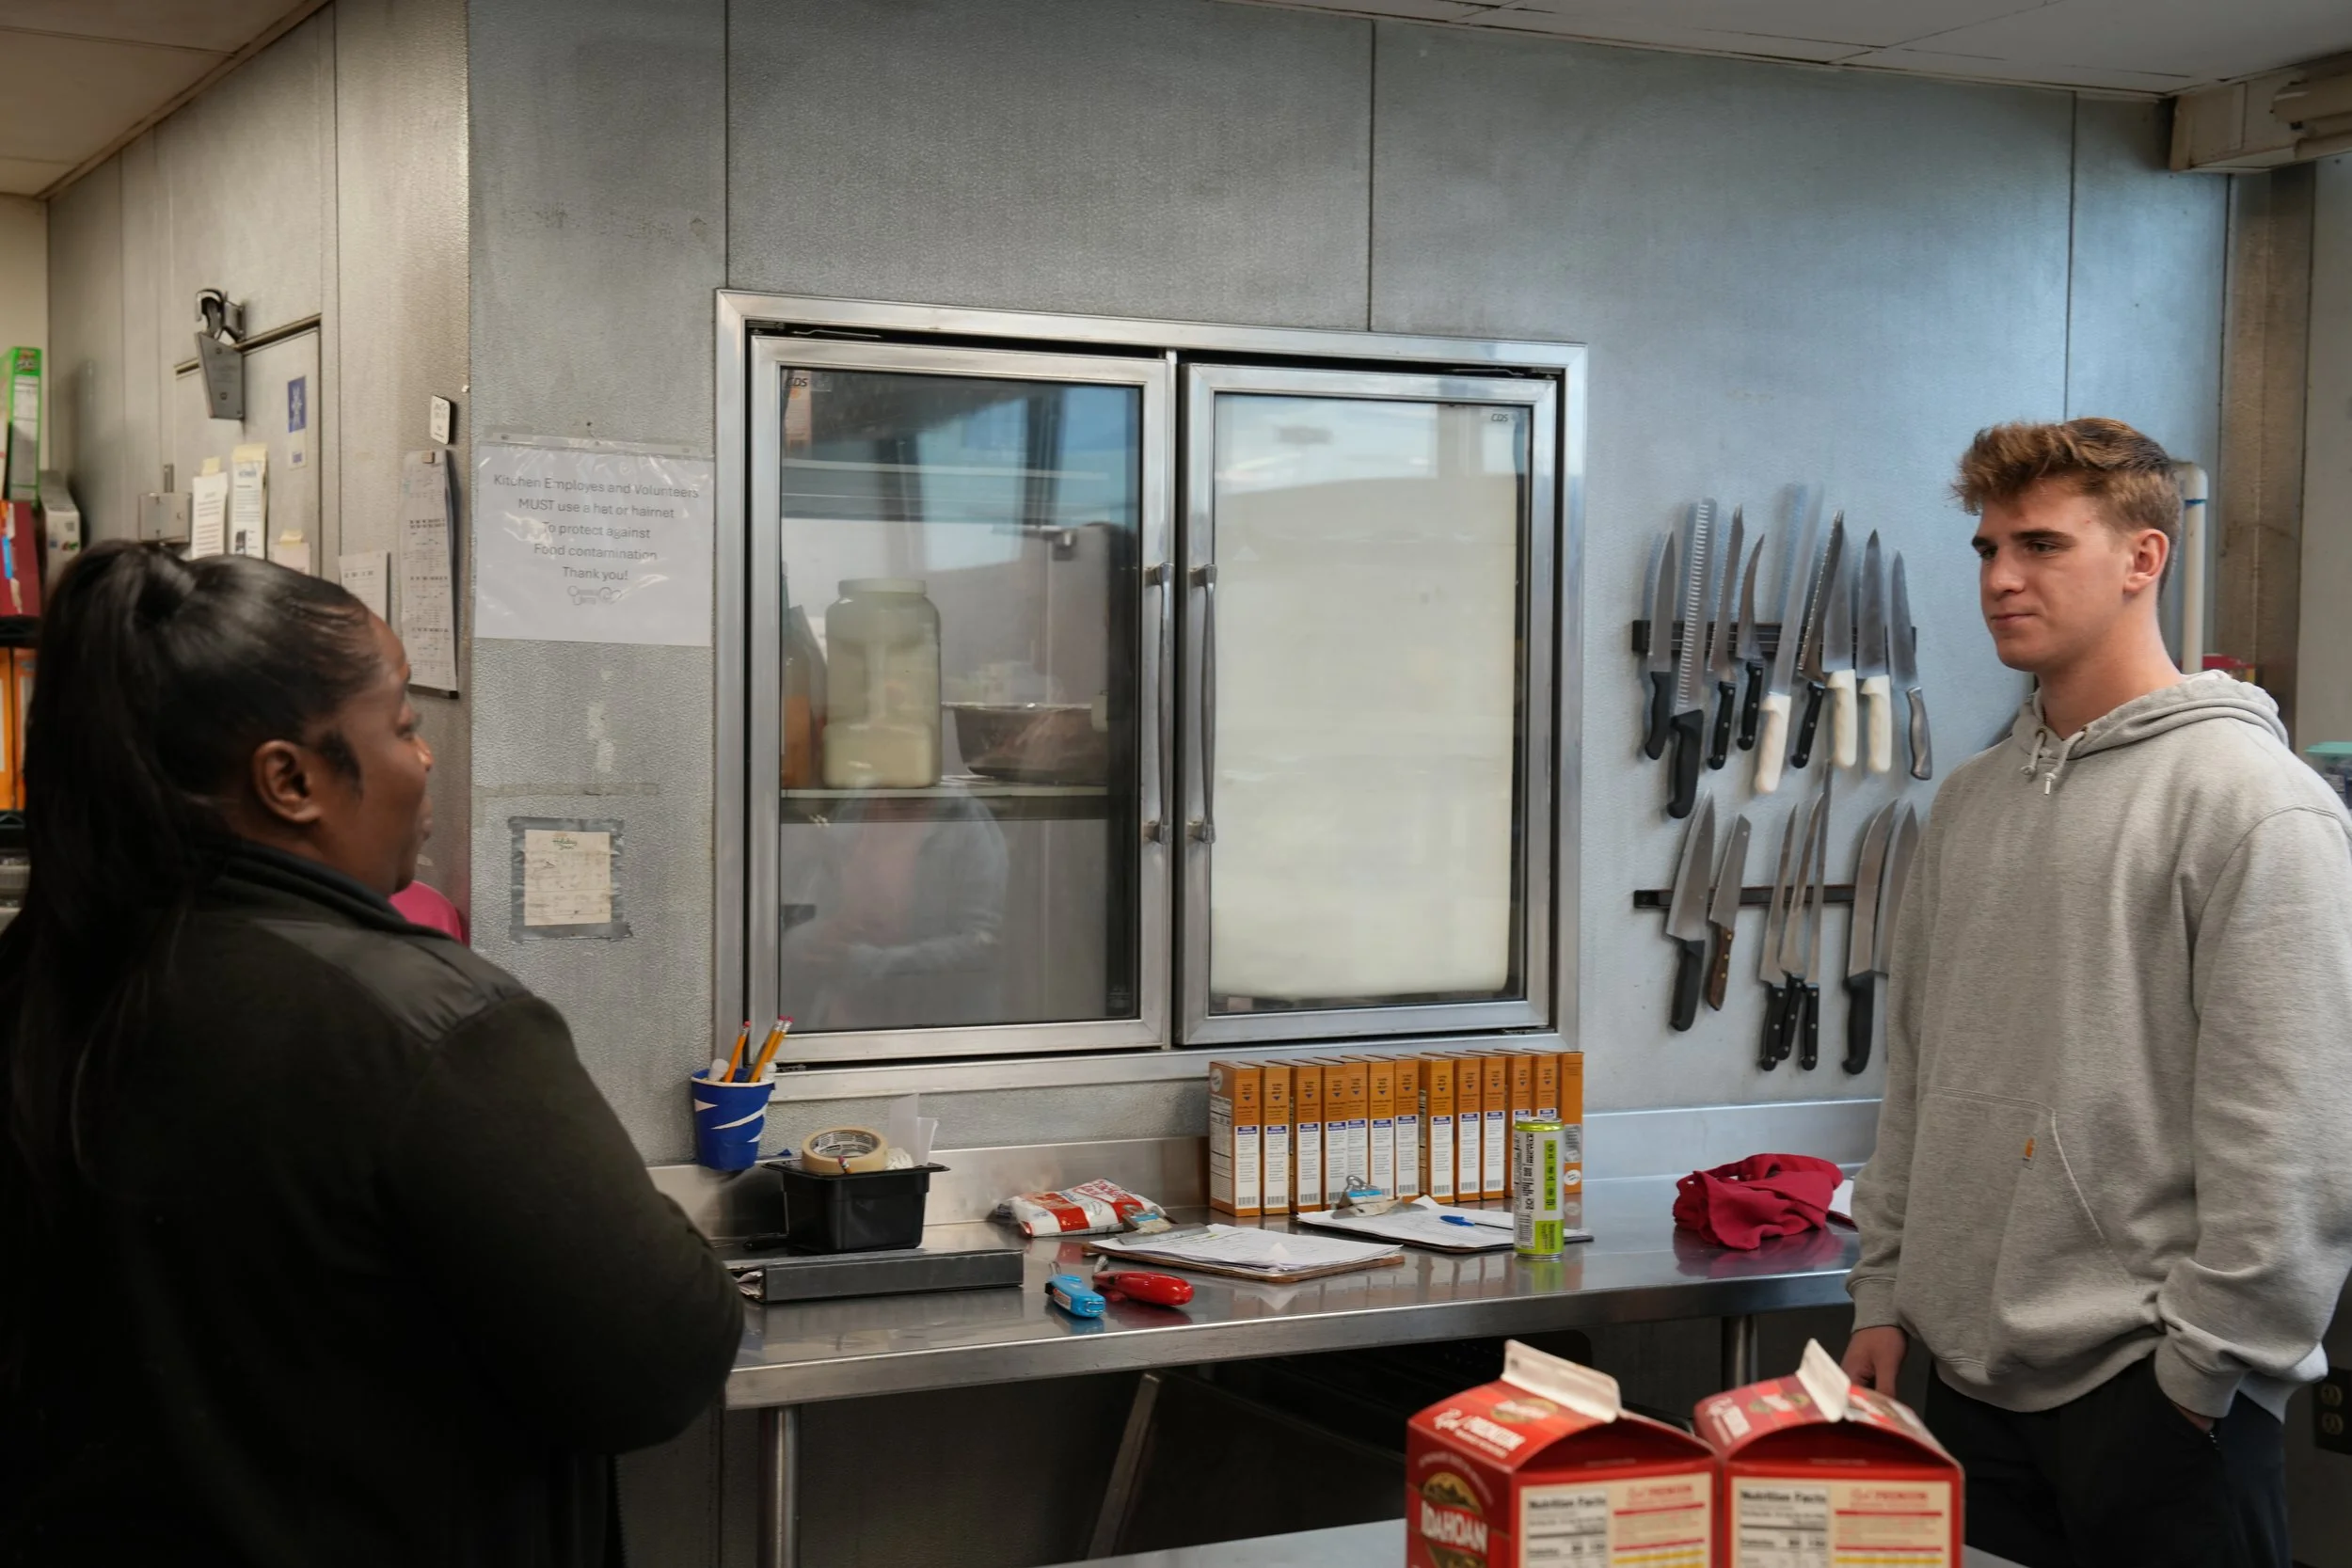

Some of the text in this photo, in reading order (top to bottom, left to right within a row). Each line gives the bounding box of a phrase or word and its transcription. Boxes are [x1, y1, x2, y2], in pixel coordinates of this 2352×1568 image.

[494, 474, 542, 487] Kitchen
[608, 483, 631, 495] and
[634, 484, 699, 499] Volunteers
[518, 499, 675, 518] MUST use a hat or hairnet
[559, 524, 605, 537] protect
[606, 527, 651, 540] against
[533, 543, 658, 561] Food contamination
[562, 566, 628, 582] Thank you!
[1421, 1499, 1488, 1555] IDAHOAN
